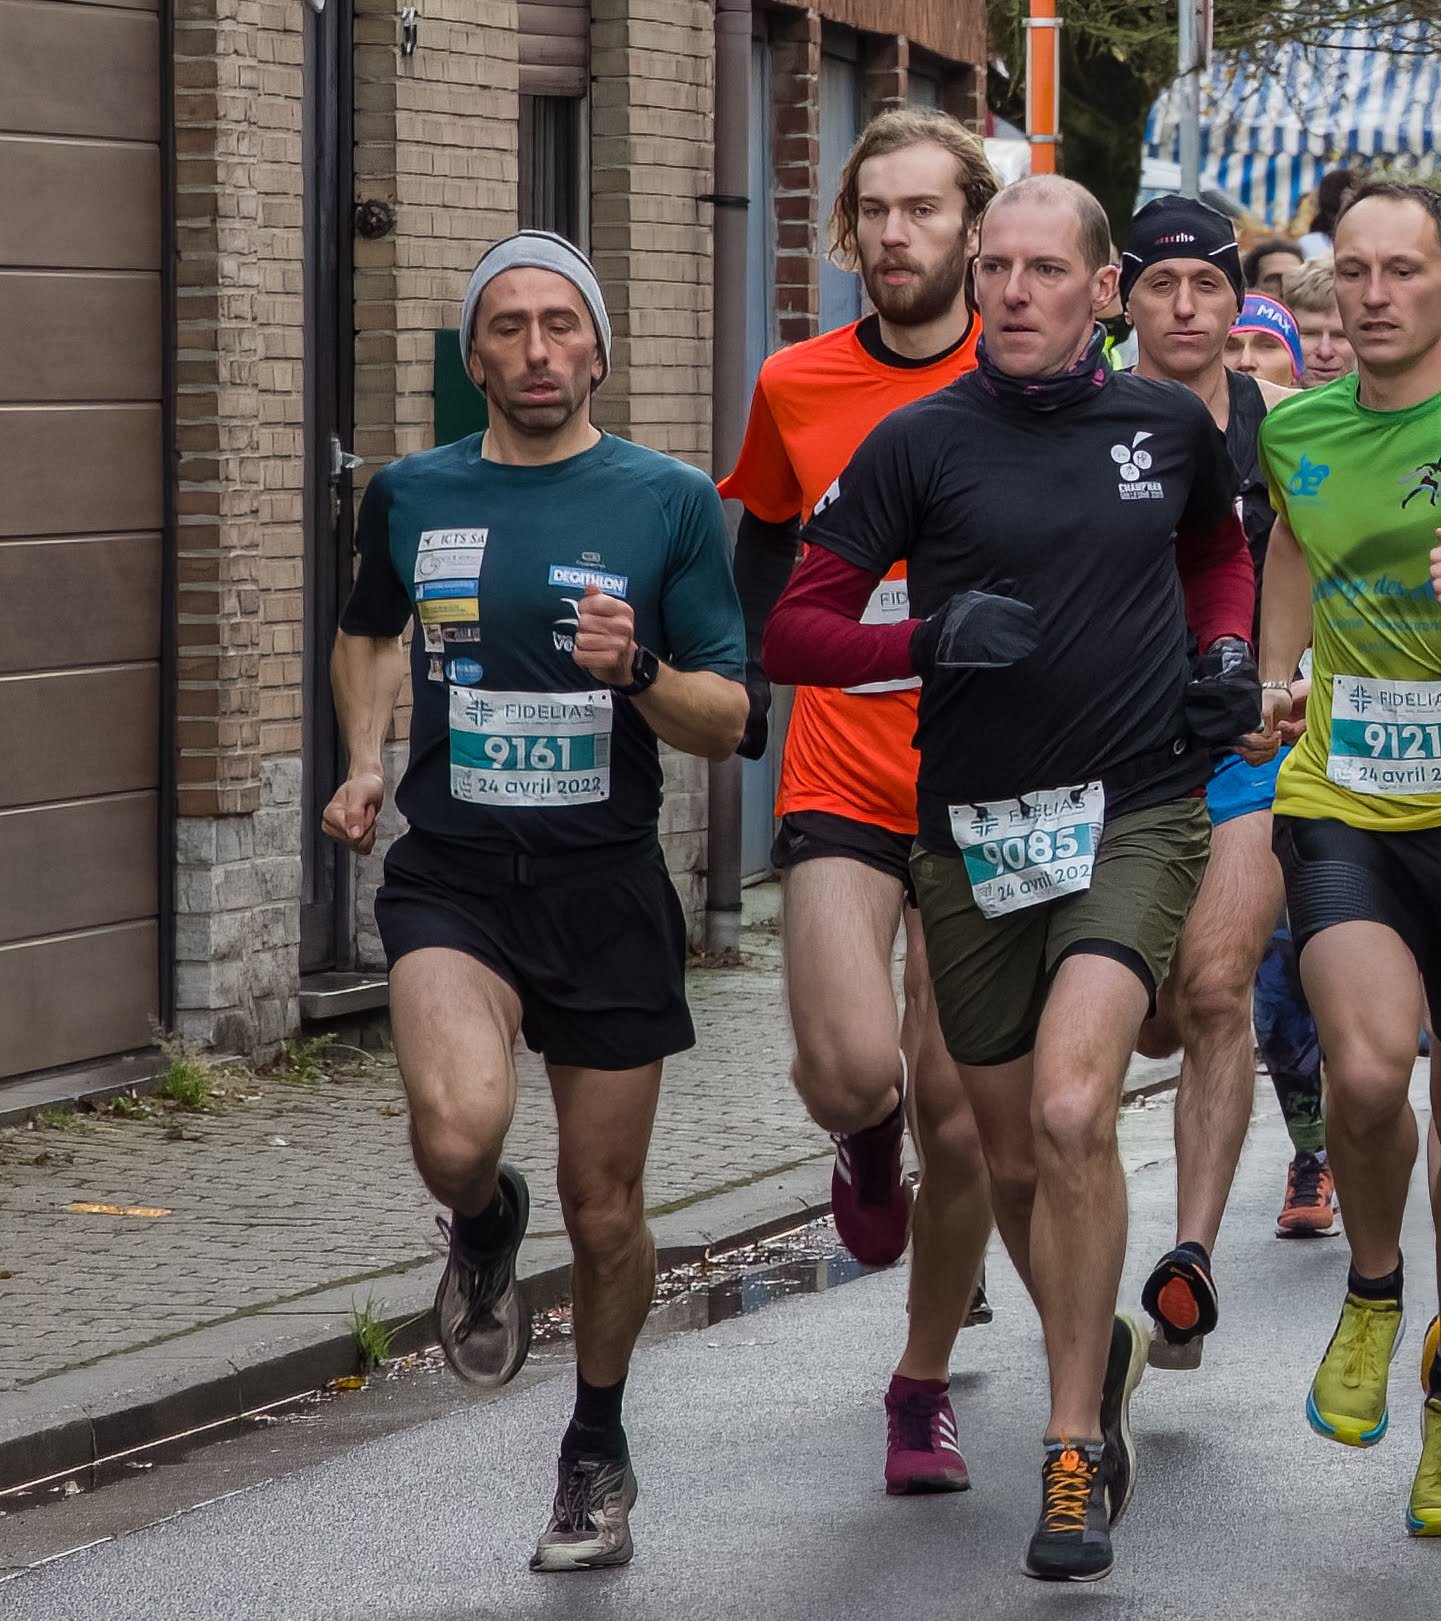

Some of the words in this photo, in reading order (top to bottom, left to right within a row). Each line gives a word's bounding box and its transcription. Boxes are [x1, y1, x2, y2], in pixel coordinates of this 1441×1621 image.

[553, 569, 625, 592] DECATHLON
[881, 591, 908, 607] FID
[505, 703, 594, 719] FIDELIAS
[1364, 723, 1441, 759] 9121
[484, 737, 570, 770] 9161
[478, 778, 499, 793] 24
[505, 778, 550, 795] avril
[557, 776, 601, 794] 2022
[1359, 766, 1378, 782] 24
[1382, 766, 1425, 784] avril
[983, 827, 1079, 876] 9085
[997, 882, 1015, 902] 24
[1020, 871, 1053, 894] avril
[1055, 863, 1091, 885] 202
